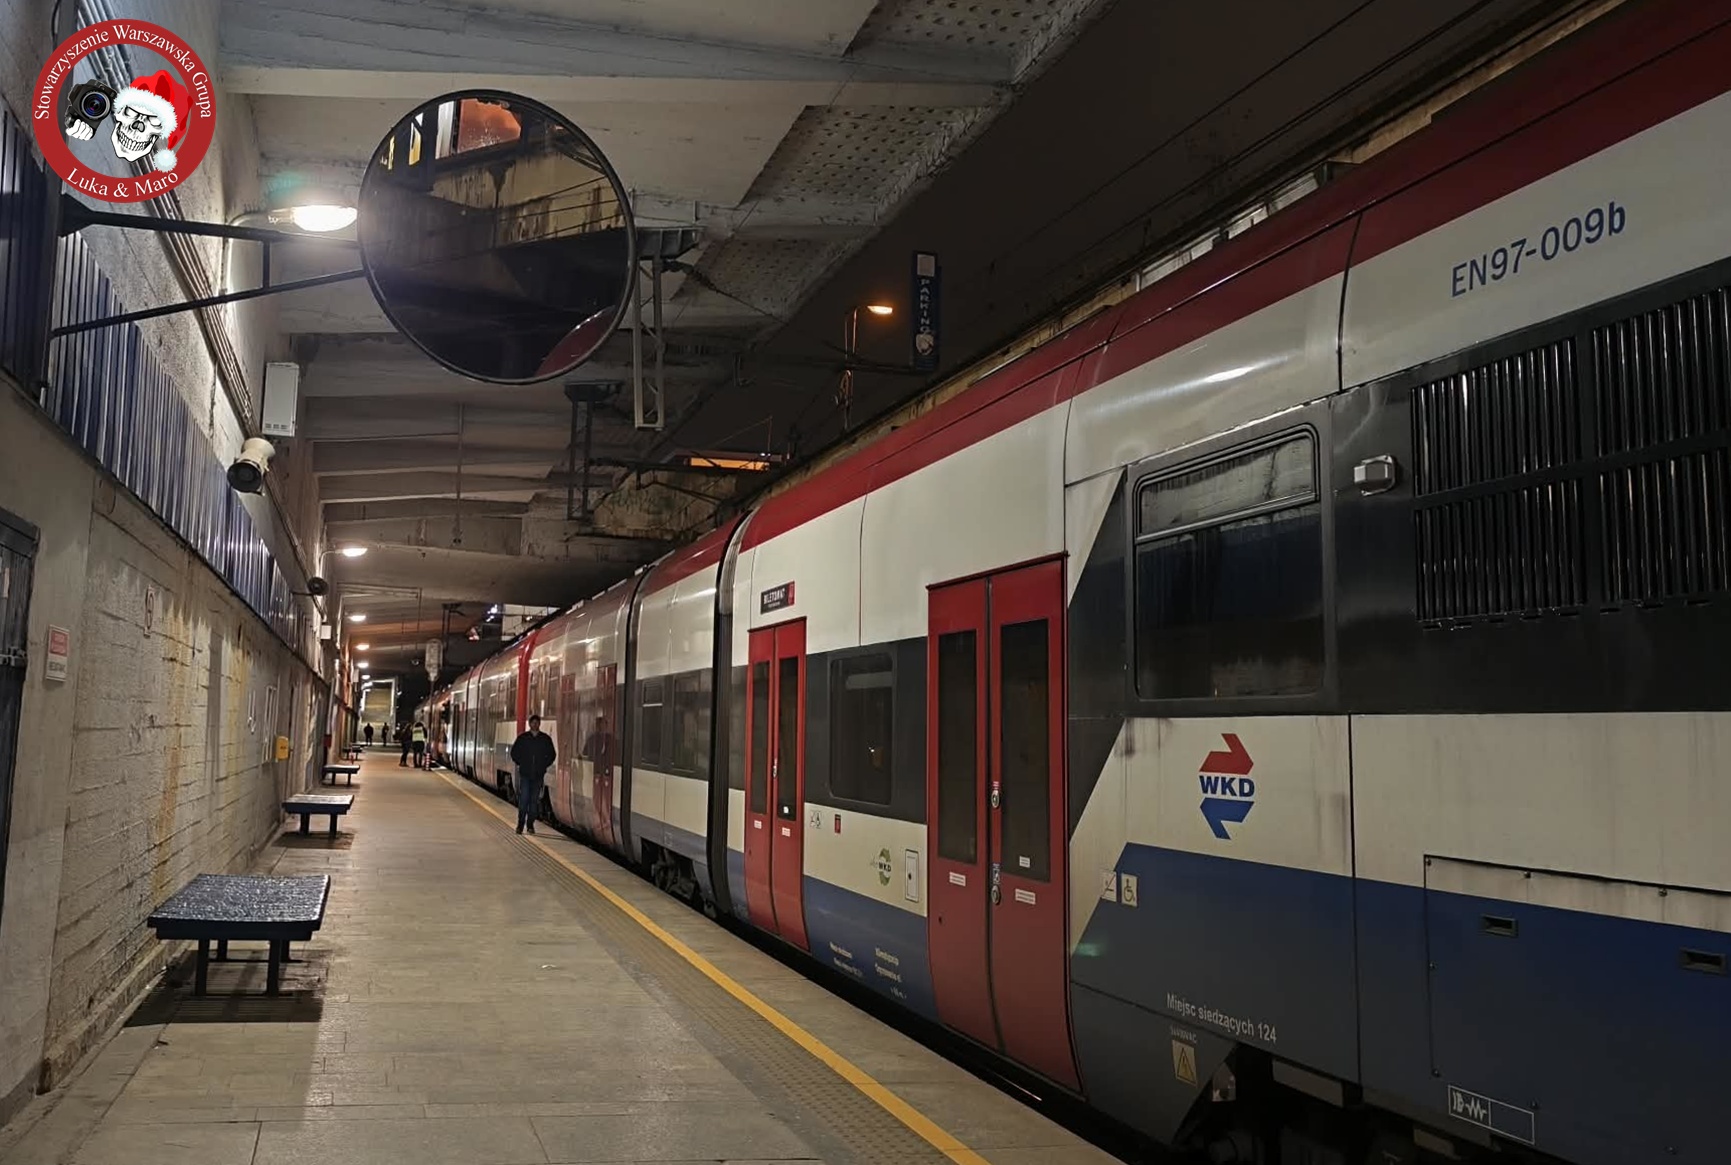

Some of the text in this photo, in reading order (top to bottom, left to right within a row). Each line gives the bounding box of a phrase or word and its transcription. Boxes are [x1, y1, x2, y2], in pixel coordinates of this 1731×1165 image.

[1452, 201, 1626, 297] EN97-009b
[1198, 775, 1255, 797] WKD
[1166, 992, 1277, 1044] Miejsc siedzących 124
